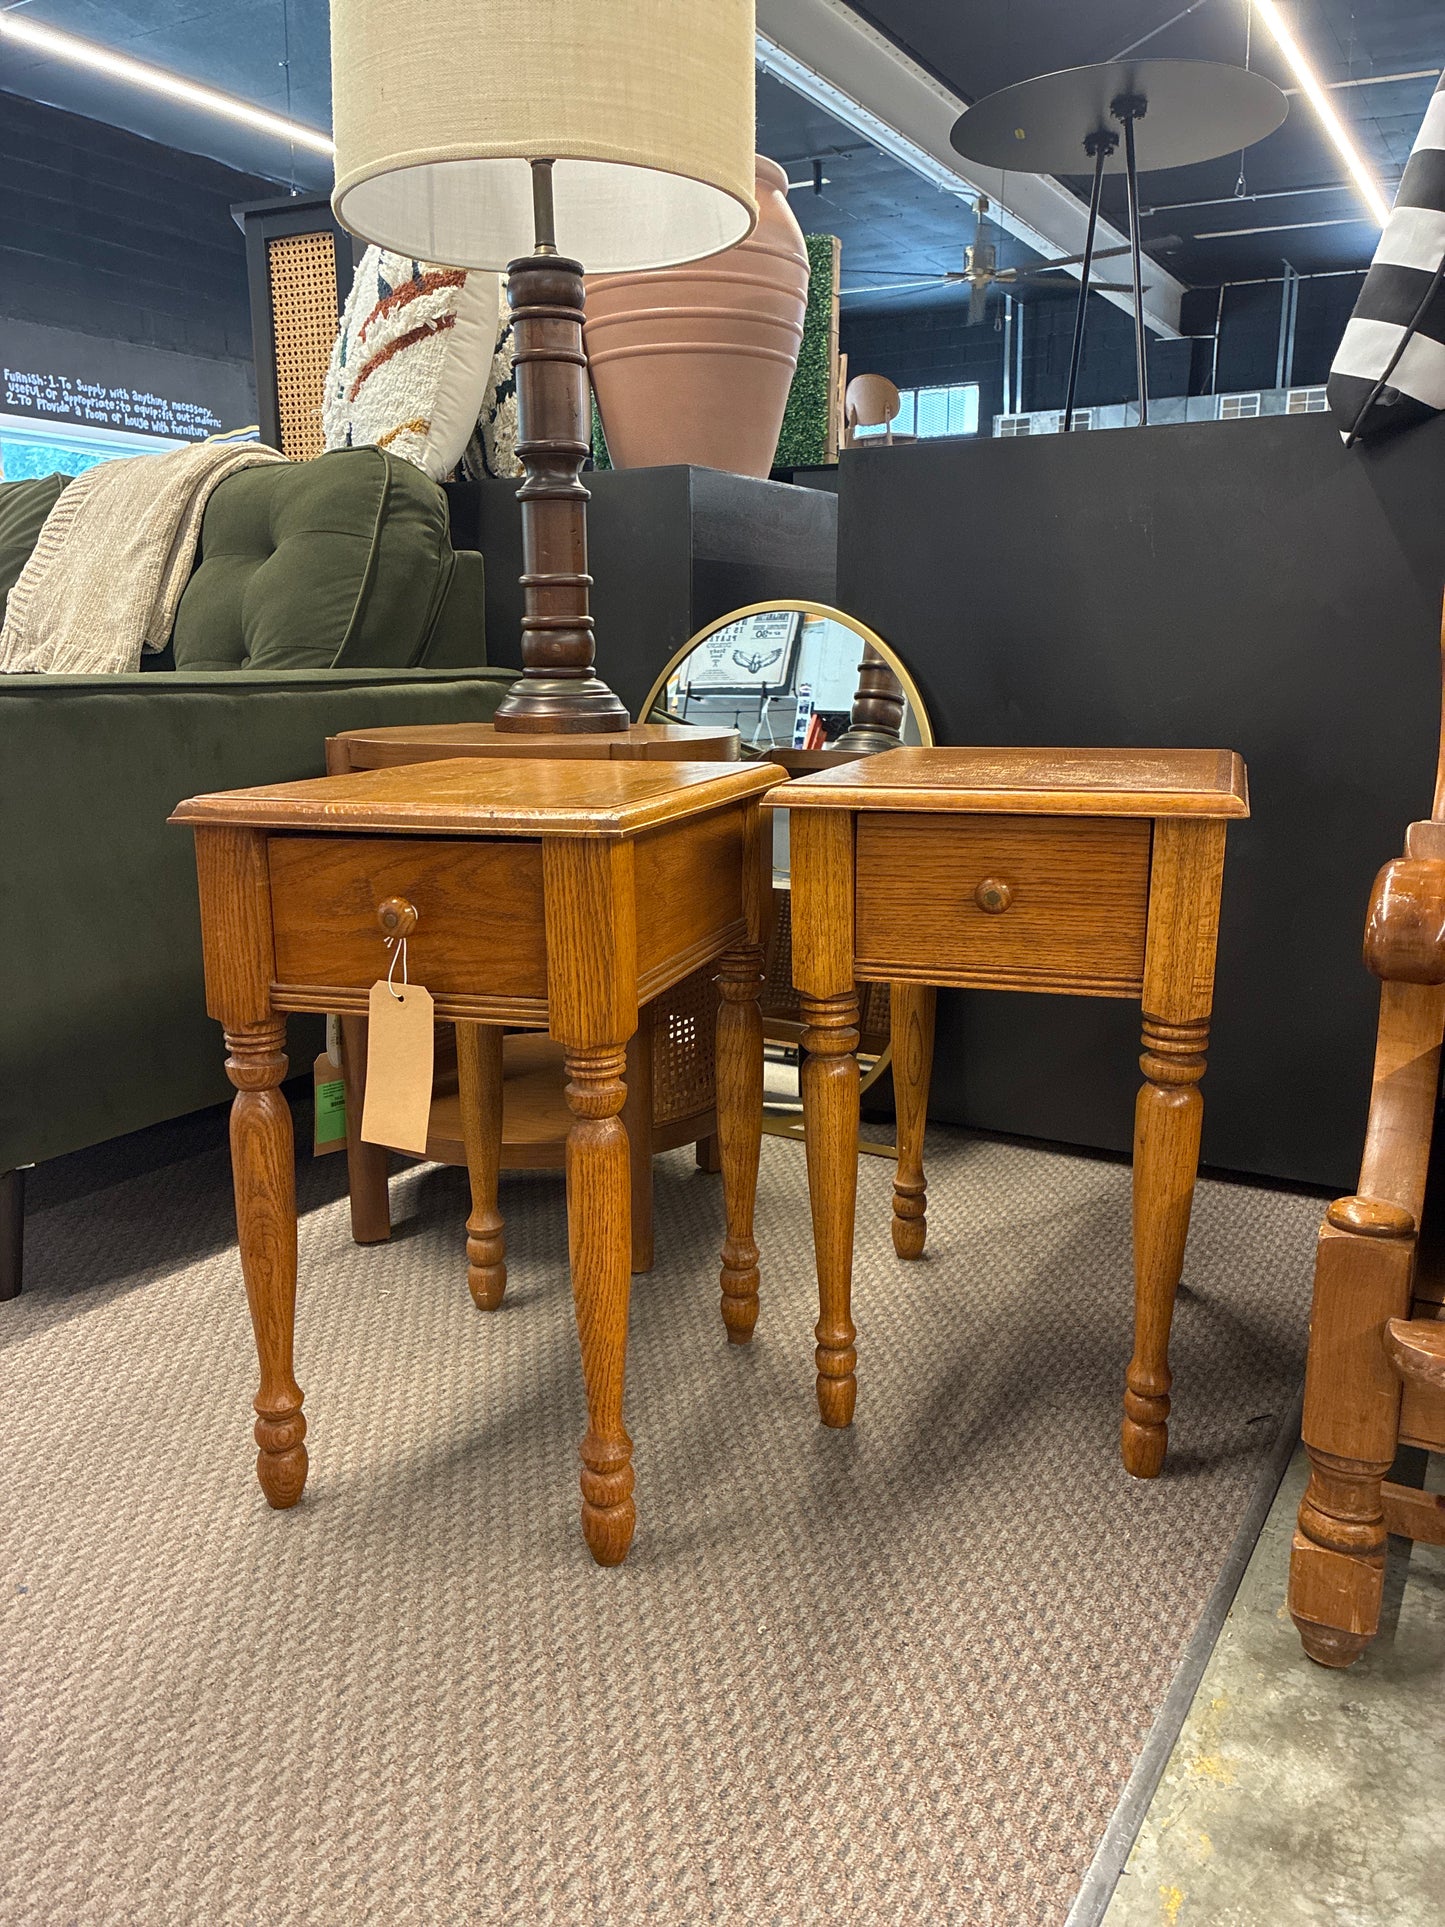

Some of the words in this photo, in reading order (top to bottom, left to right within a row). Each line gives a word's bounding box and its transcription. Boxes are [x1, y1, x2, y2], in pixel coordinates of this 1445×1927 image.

[132, 390, 168, 411] anything
[75, 405, 82, 416] a
[85, 407, 108, 422] room
[111, 413, 122, 424] or
[124, 413, 149, 429] house
